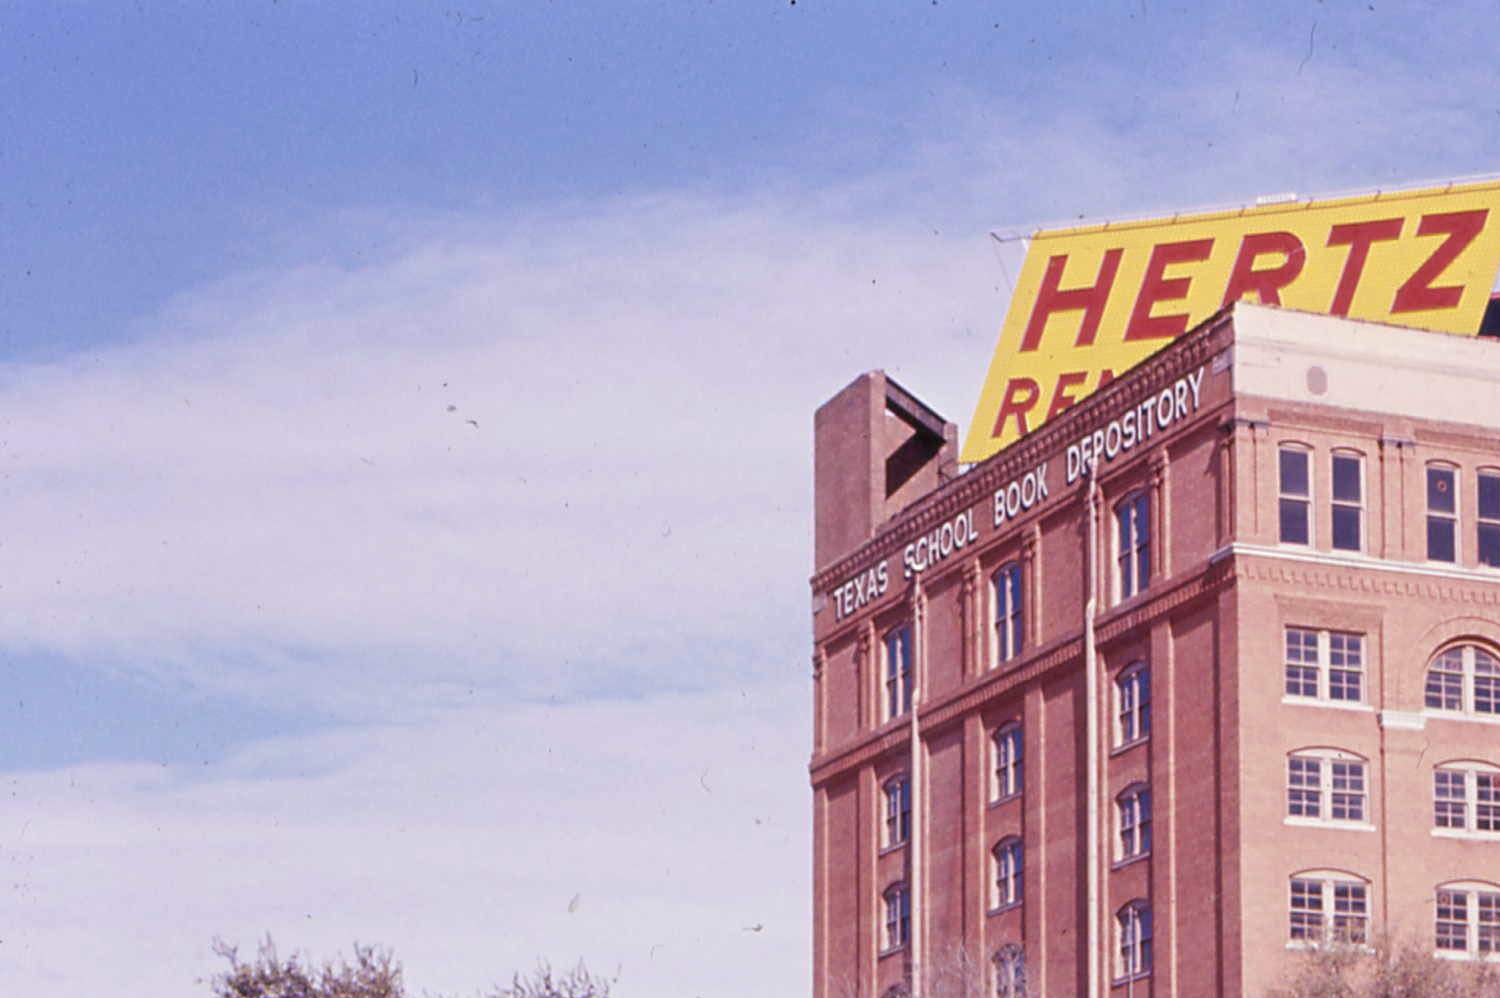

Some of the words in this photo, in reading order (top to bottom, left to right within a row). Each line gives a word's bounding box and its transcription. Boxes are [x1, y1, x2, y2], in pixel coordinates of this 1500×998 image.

[1019, 208, 1491, 353] HERTZ
[833, 560, 888, 620] TEXAS
[904, 508, 979, 578] SCHOOL
[994, 463, 1050, 526] BOOK
[1067, 366, 1204, 484] DEPOSITORY
